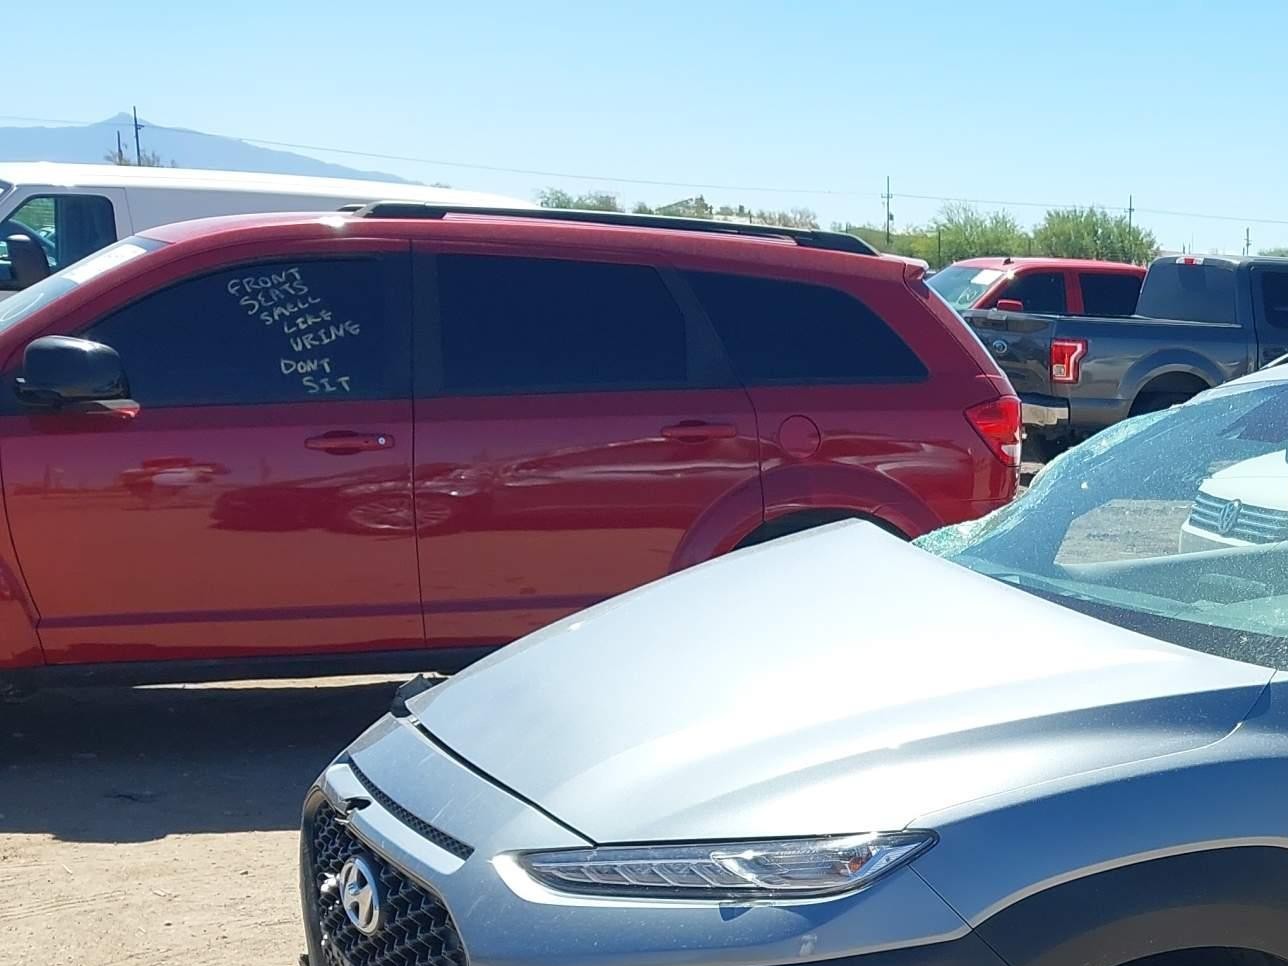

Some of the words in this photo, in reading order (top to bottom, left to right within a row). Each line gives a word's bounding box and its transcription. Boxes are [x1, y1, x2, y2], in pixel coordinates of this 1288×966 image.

[227, 267, 301, 296] FRONT
[239, 281, 309, 316] SEATS
[260, 296, 321, 325] SMELL
[283, 309, 332, 334] LIKE
[289, 320, 361, 352] URINE
[280, 358, 331, 375] DONT
[302, 376, 351, 393] SIT
